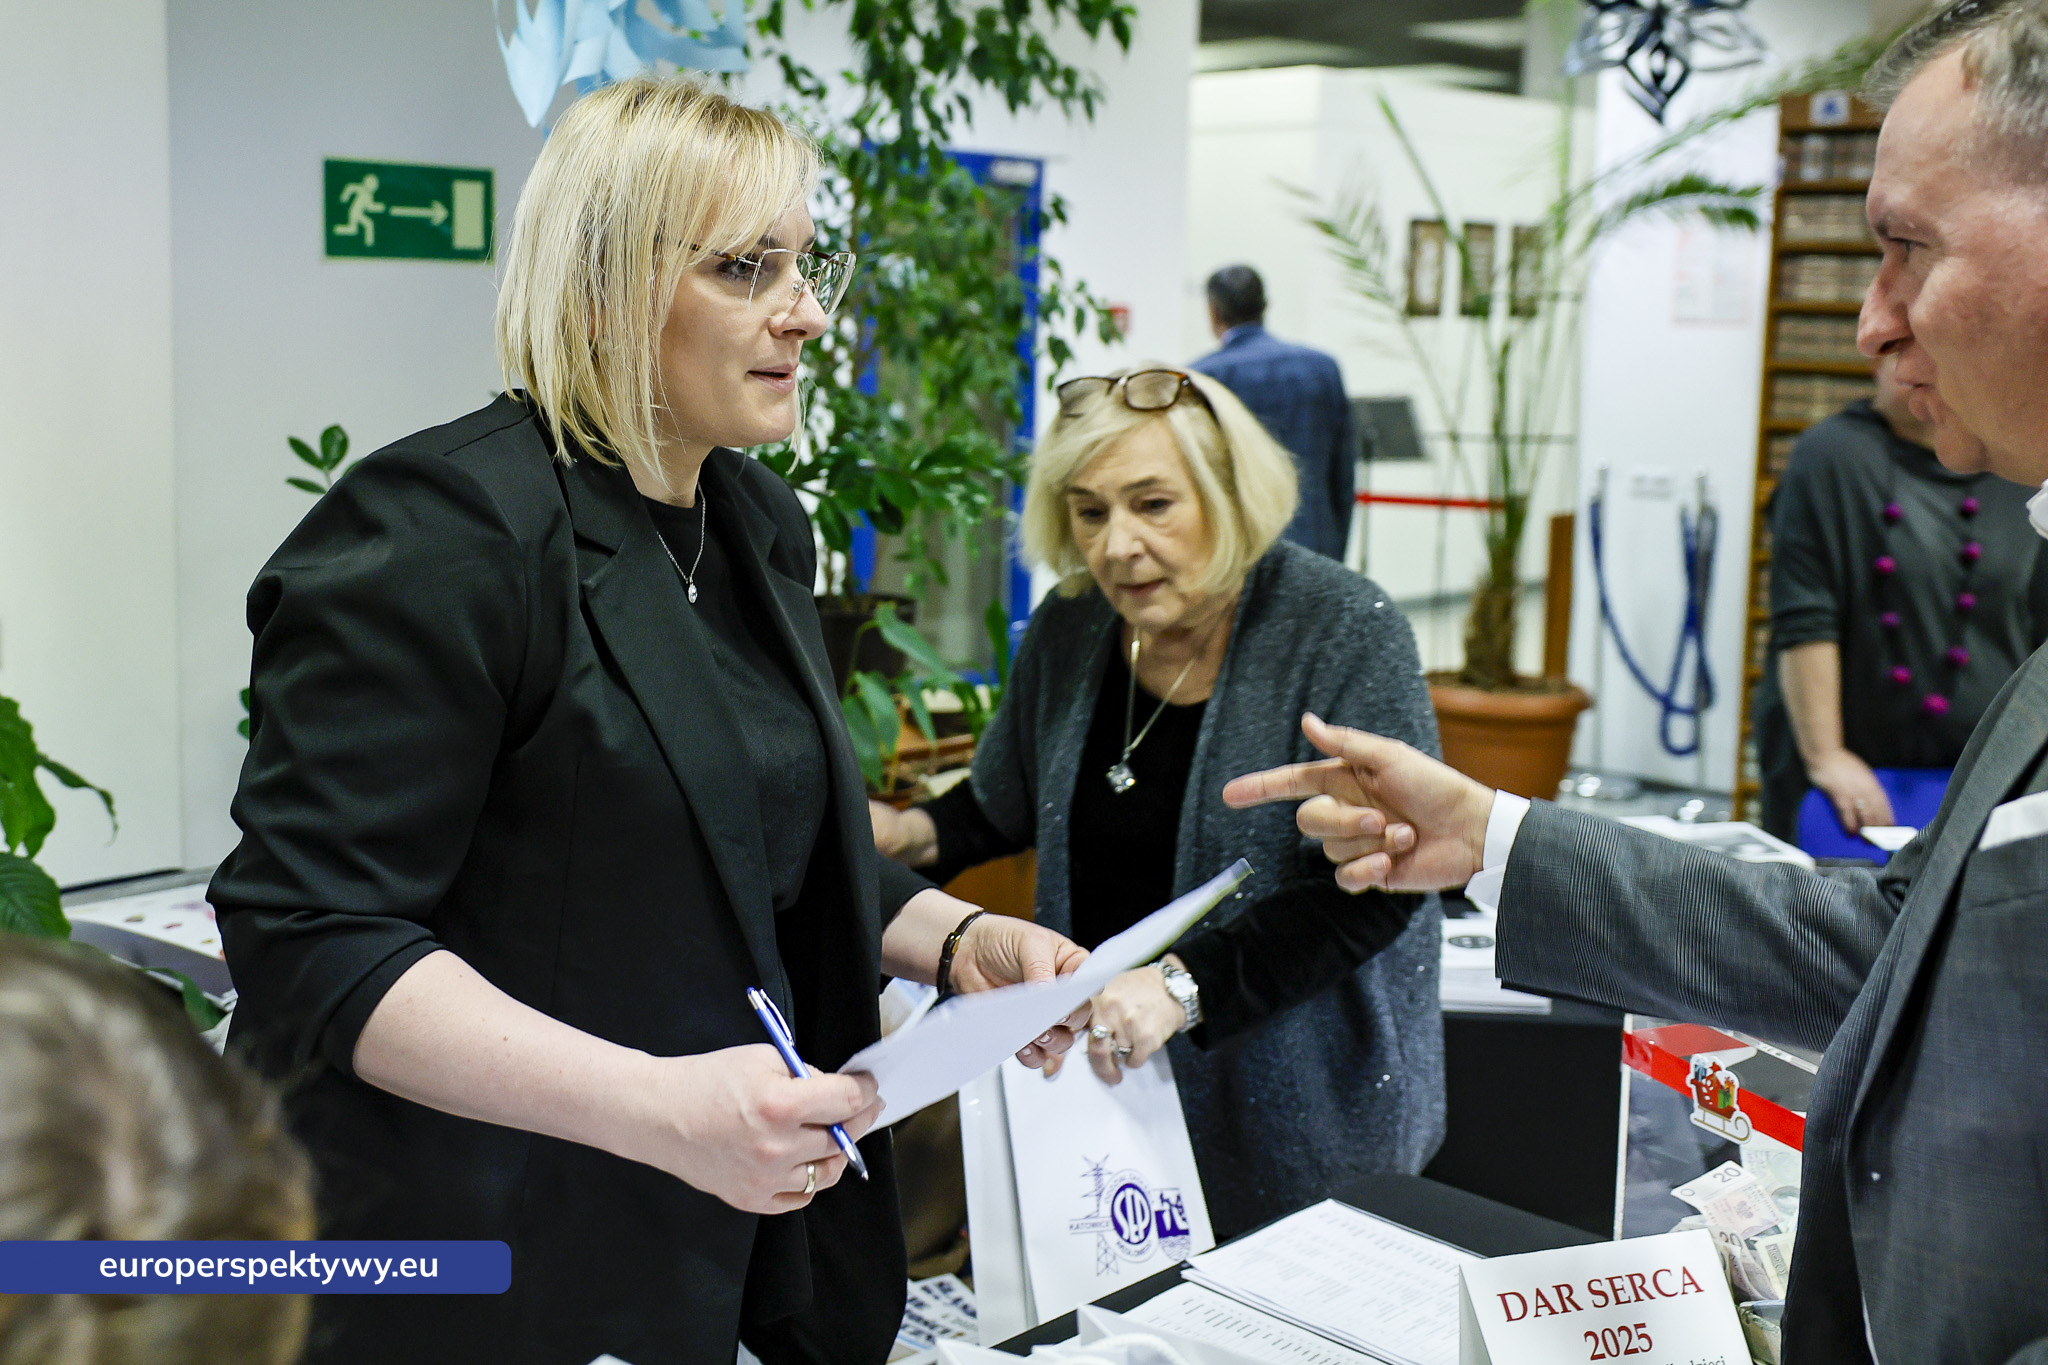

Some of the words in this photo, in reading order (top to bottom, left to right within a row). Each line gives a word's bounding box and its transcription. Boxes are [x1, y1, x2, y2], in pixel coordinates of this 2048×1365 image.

[1713, 1167, 1741, 1183] 20
[1113, 1186, 1150, 1243] SEP
[1497, 1283, 1583, 1322] DAR
[1587, 1266, 1704, 1308] SERCA
[1584, 1322, 1653, 1361] 2025
